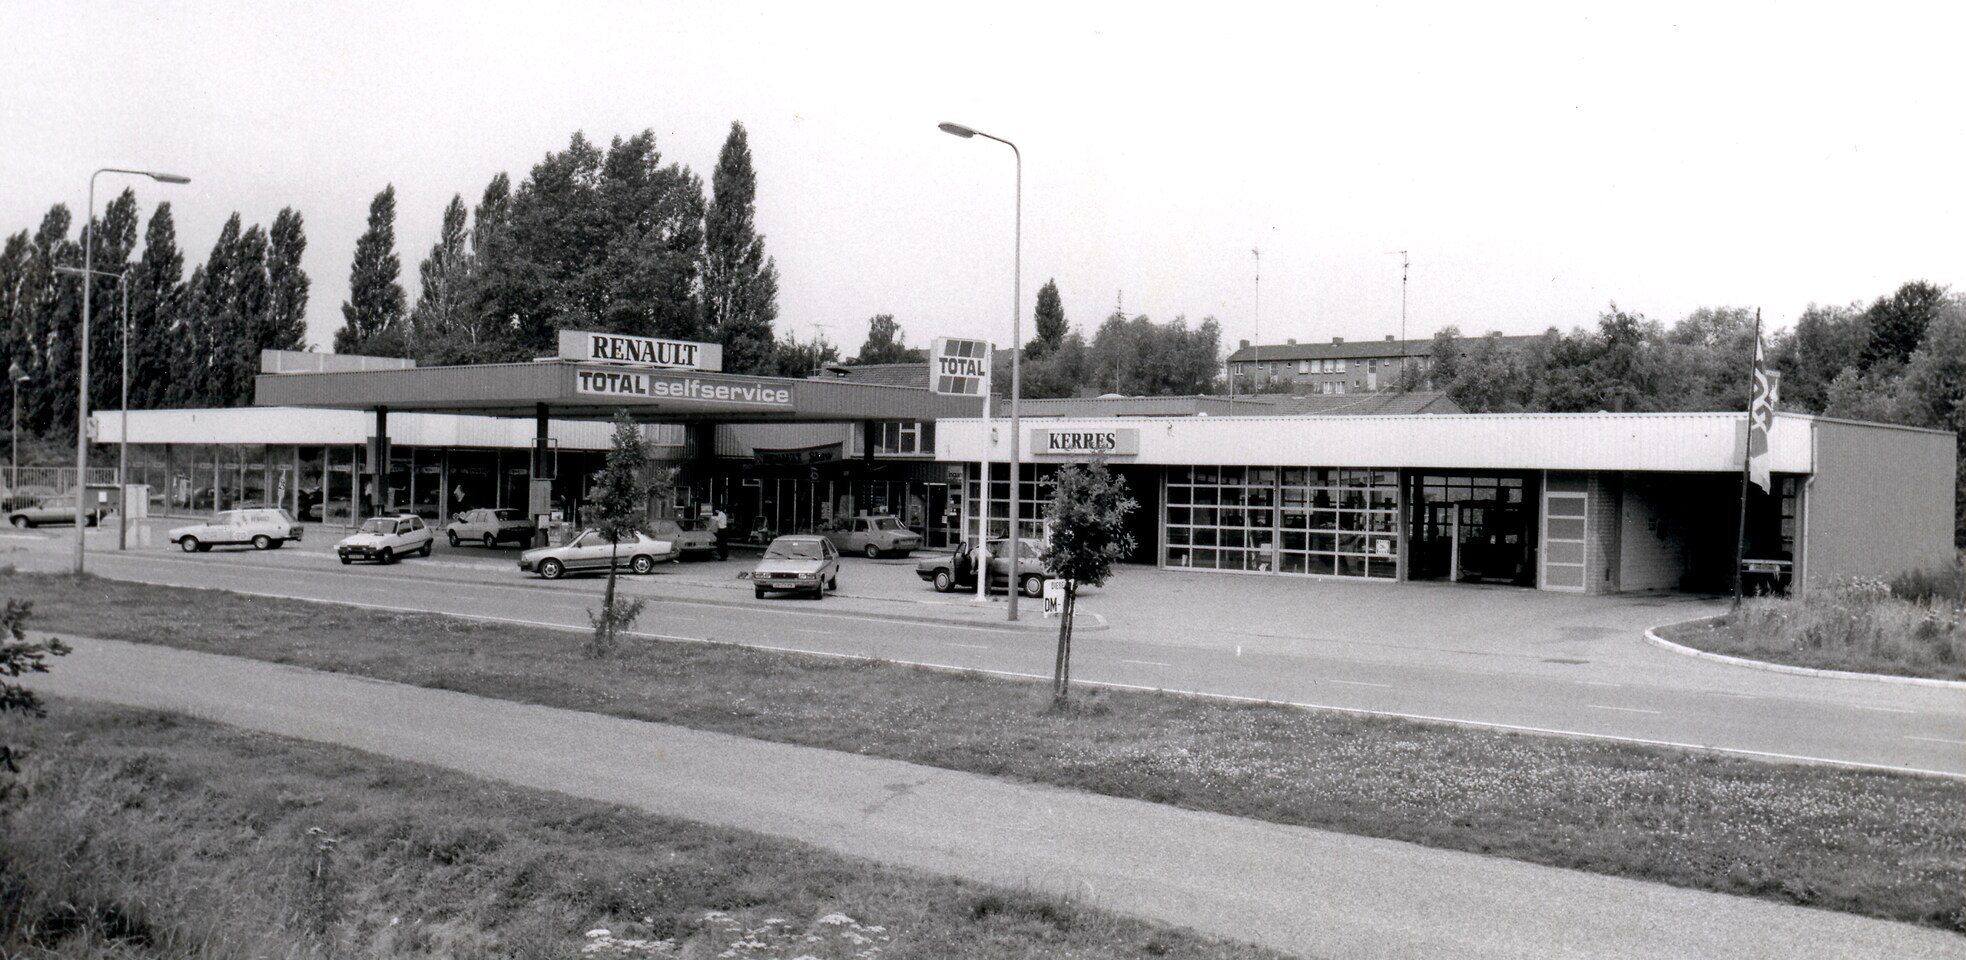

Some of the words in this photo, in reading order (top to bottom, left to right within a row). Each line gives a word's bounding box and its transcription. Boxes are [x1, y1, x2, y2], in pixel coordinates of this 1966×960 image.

[592, 335, 698, 367] RENAULT
[938, 357, 986, 377] TOTAL
[579, 371, 646, 395] TOTAL
[654, 379, 789, 403] selfservice
[1048, 432, 1116, 450] KERRES
[1051, 581, 1067, 590] DIESE
